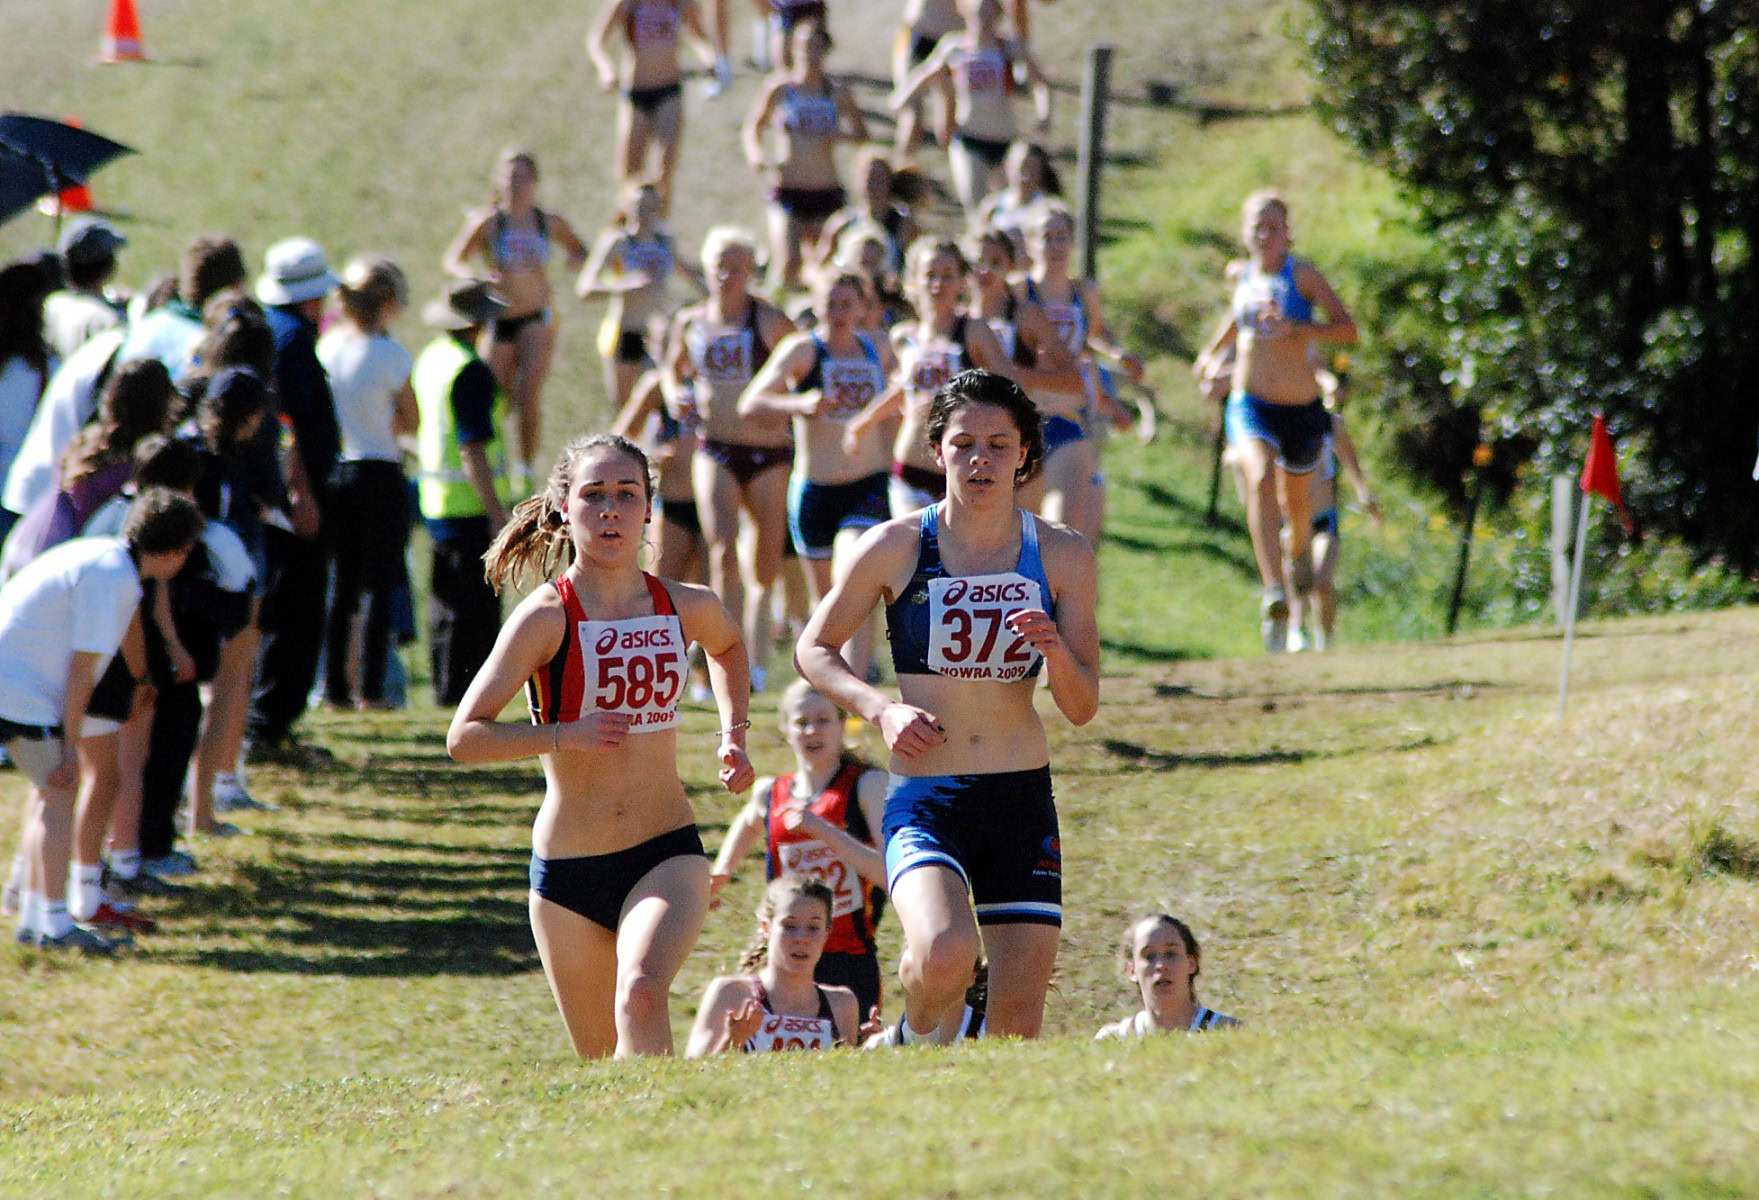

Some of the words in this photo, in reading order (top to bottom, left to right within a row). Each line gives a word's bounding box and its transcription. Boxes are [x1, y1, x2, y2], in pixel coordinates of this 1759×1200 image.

[941, 608, 1031, 663] 372
[595, 652, 680, 710] 585
[997, 665, 1026, 680] 2009
[646, 710, 675, 724] 2009
